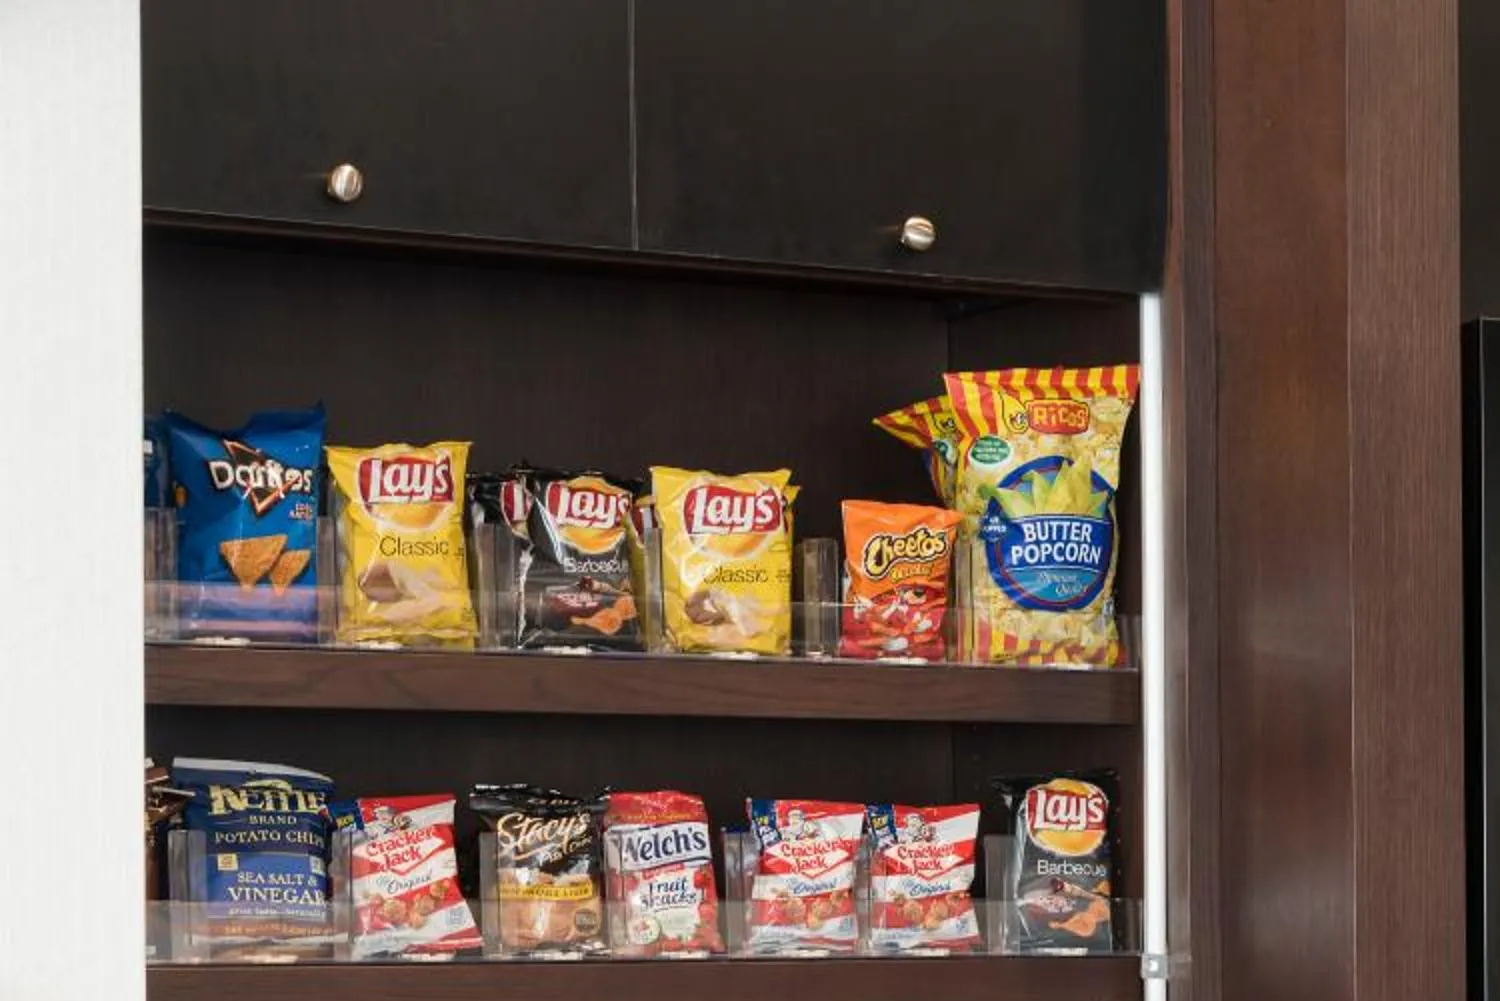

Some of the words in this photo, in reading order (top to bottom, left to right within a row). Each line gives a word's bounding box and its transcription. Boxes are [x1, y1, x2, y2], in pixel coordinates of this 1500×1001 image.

[209, 459, 313, 493] Doritos
[368, 450, 449, 504] Lay's
[691, 482, 775, 535] Lay's
[1021, 520, 1093, 543] BUTTER
[379, 535, 449, 558] Classic
[865, 528, 946, 577] Cheetos
[1011, 541, 1101, 565] POPCORN
[703, 564, 769, 585] Classic
[249, 815, 297, 825] BRAND
[1034, 786, 1105, 832] Lay's
[214, 829, 281, 844] POTATO
[365, 824, 434, 857] Cracker
[497, 806, 592, 855] Stacy's
[624, 827, 707, 862] Welch's
[896, 843, 958, 861] Cracker
[379, 845, 422, 873] Jack
[1037, 860, 1107, 877] Barbecue
[237, 871, 265, 884] SEA
[269, 872, 304, 885] SALT
[649, 877, 688, 896] Fruit
[227, 886, 326, 906] VINEGAR
